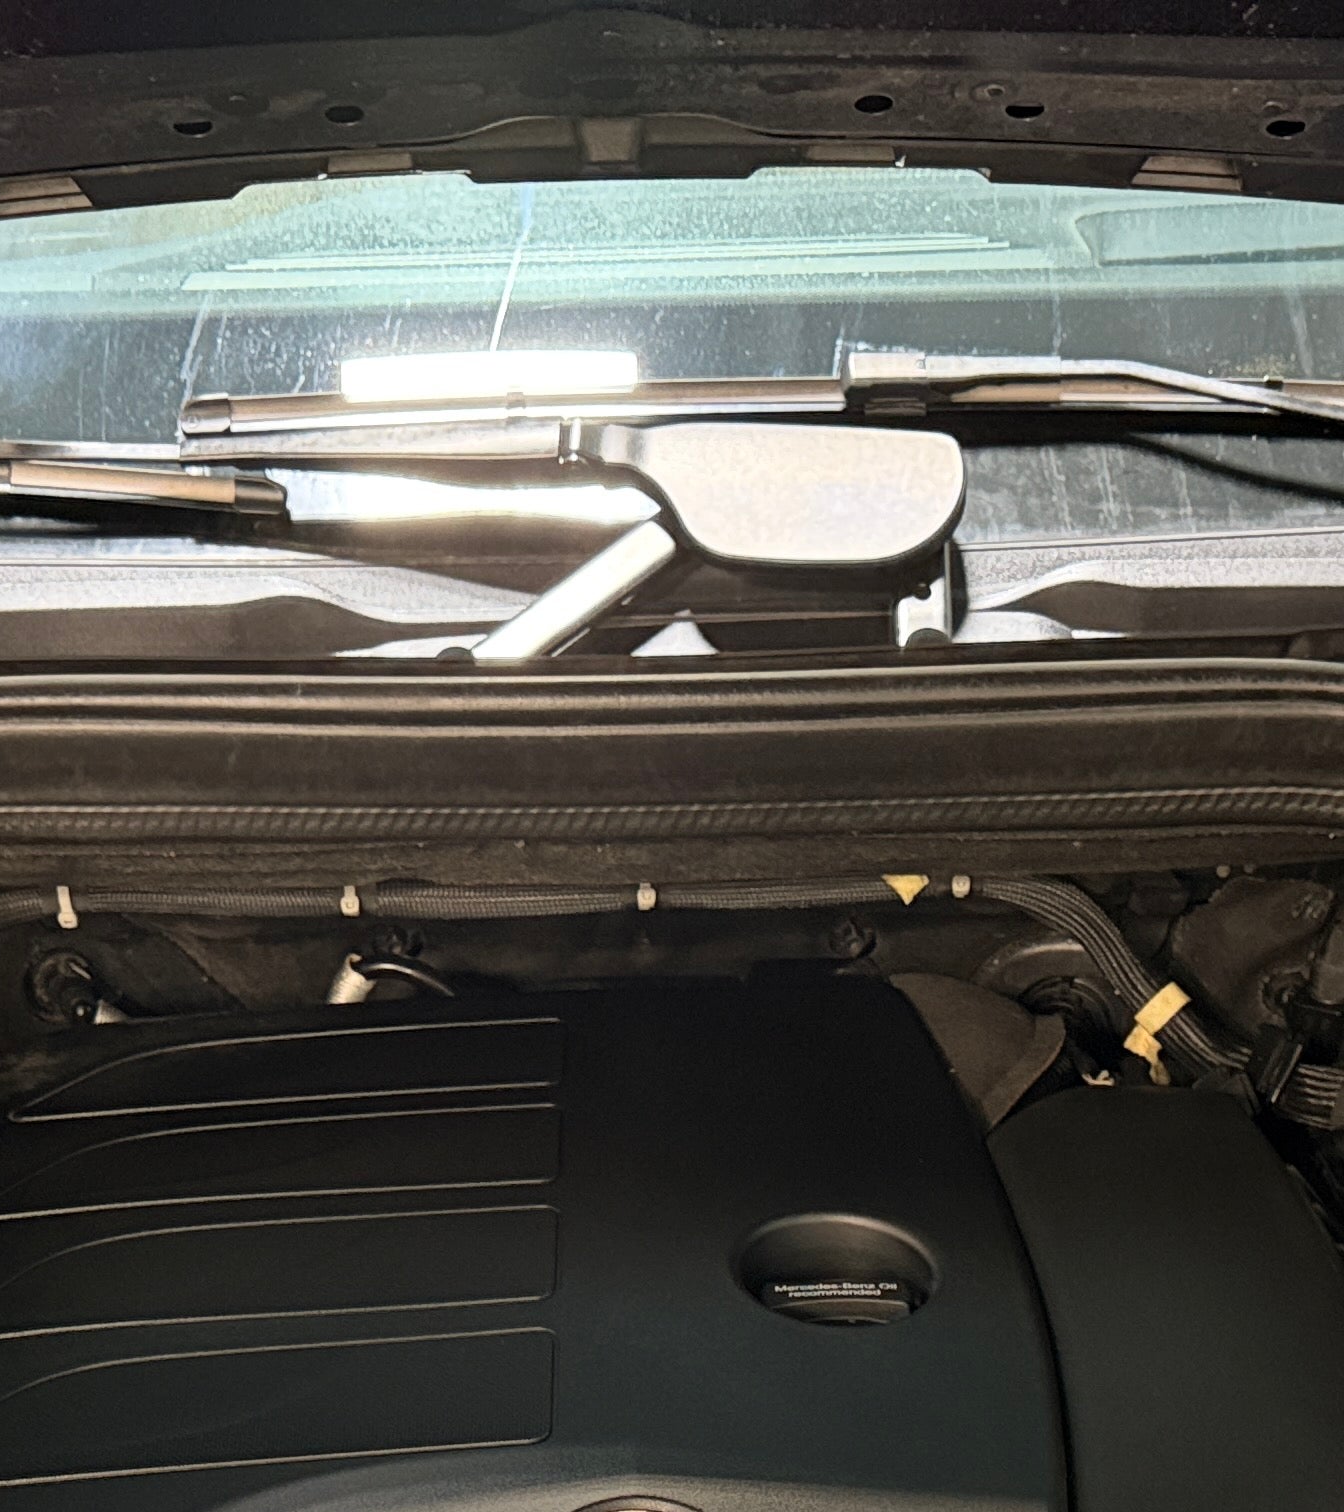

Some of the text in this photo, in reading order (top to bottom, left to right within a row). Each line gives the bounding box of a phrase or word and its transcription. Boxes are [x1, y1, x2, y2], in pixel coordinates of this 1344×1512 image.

[774, 1282, 898, 1292] Mercedes-Benz Oil
[788, 1289, 882, 1297] recommended
